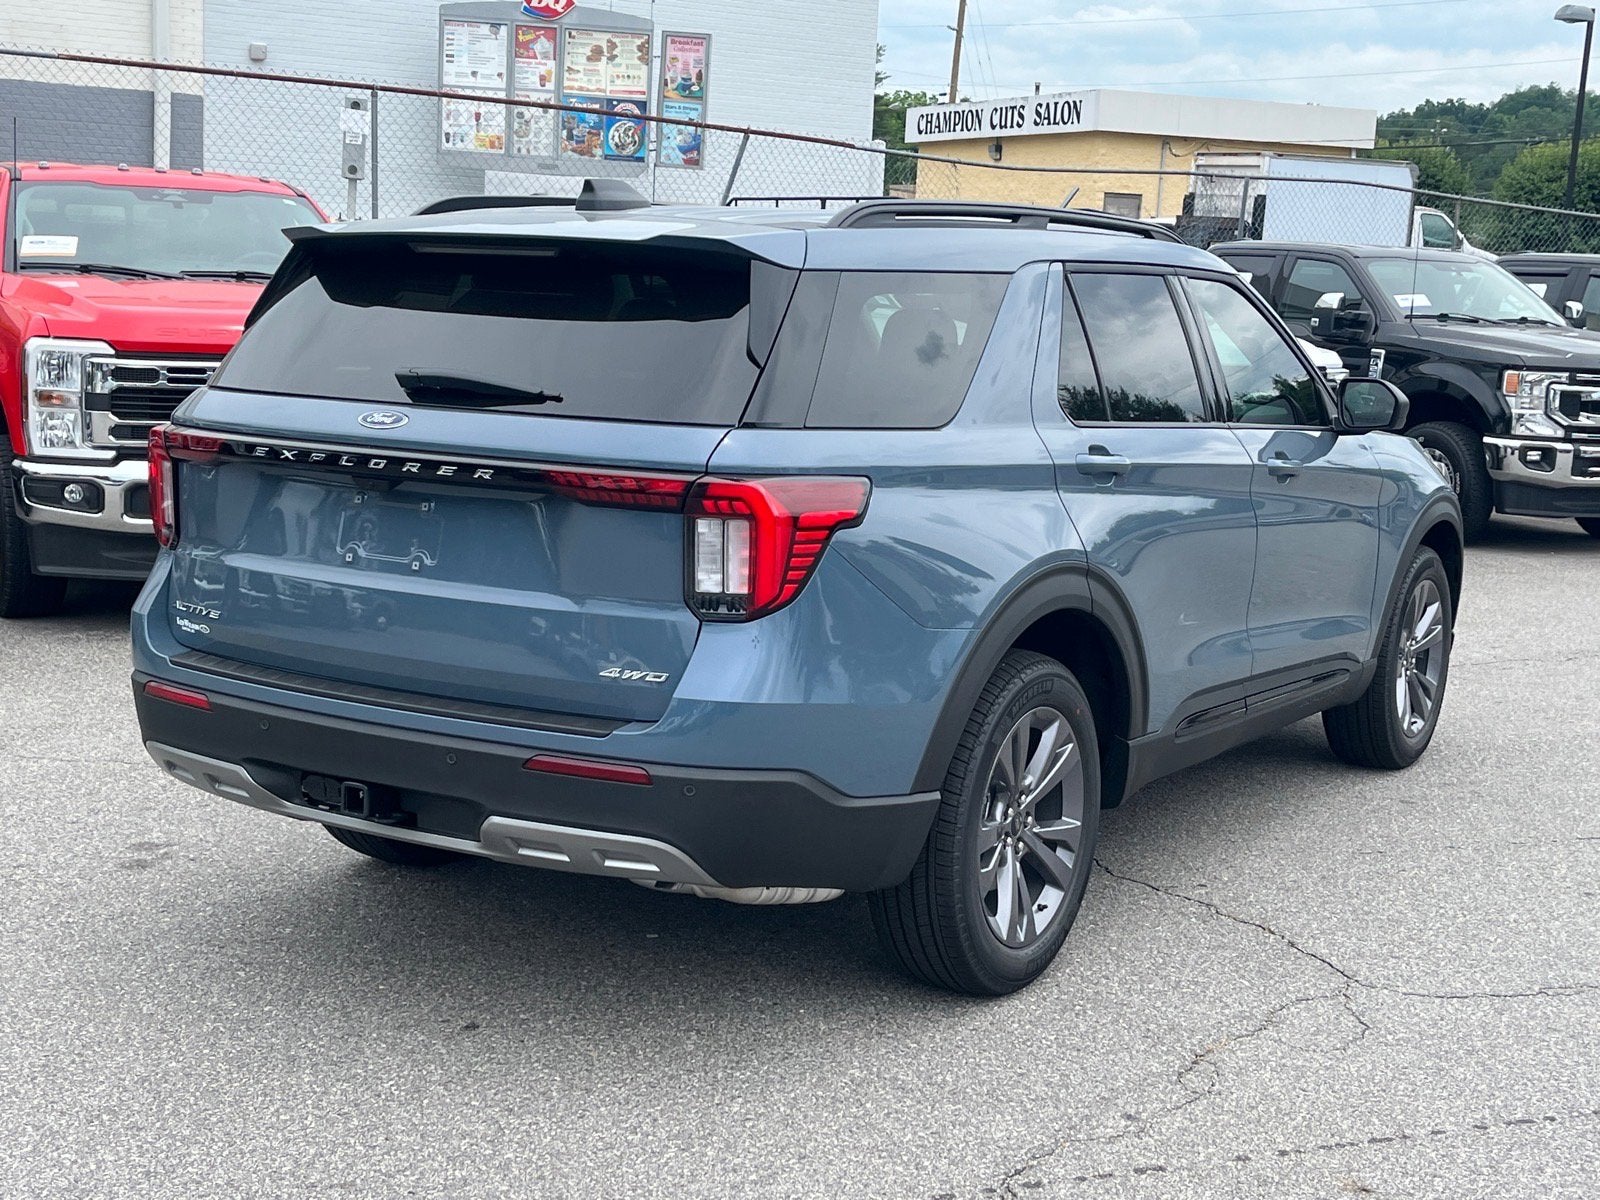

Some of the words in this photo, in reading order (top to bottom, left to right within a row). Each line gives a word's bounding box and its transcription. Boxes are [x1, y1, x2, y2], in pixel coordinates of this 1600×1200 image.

[670, 38, 704, 47] Breakfast
[917, 109, 984, 135] CHAMPION
[990, 104, 1026, 130] CUTS
[1033, 99, 1083, 127] SALON
[252, 446, 495, 480] EXPLORER
[598, 667, 670, 683] 4WD
[1010, 678, 1054, 719] MICHELIN
